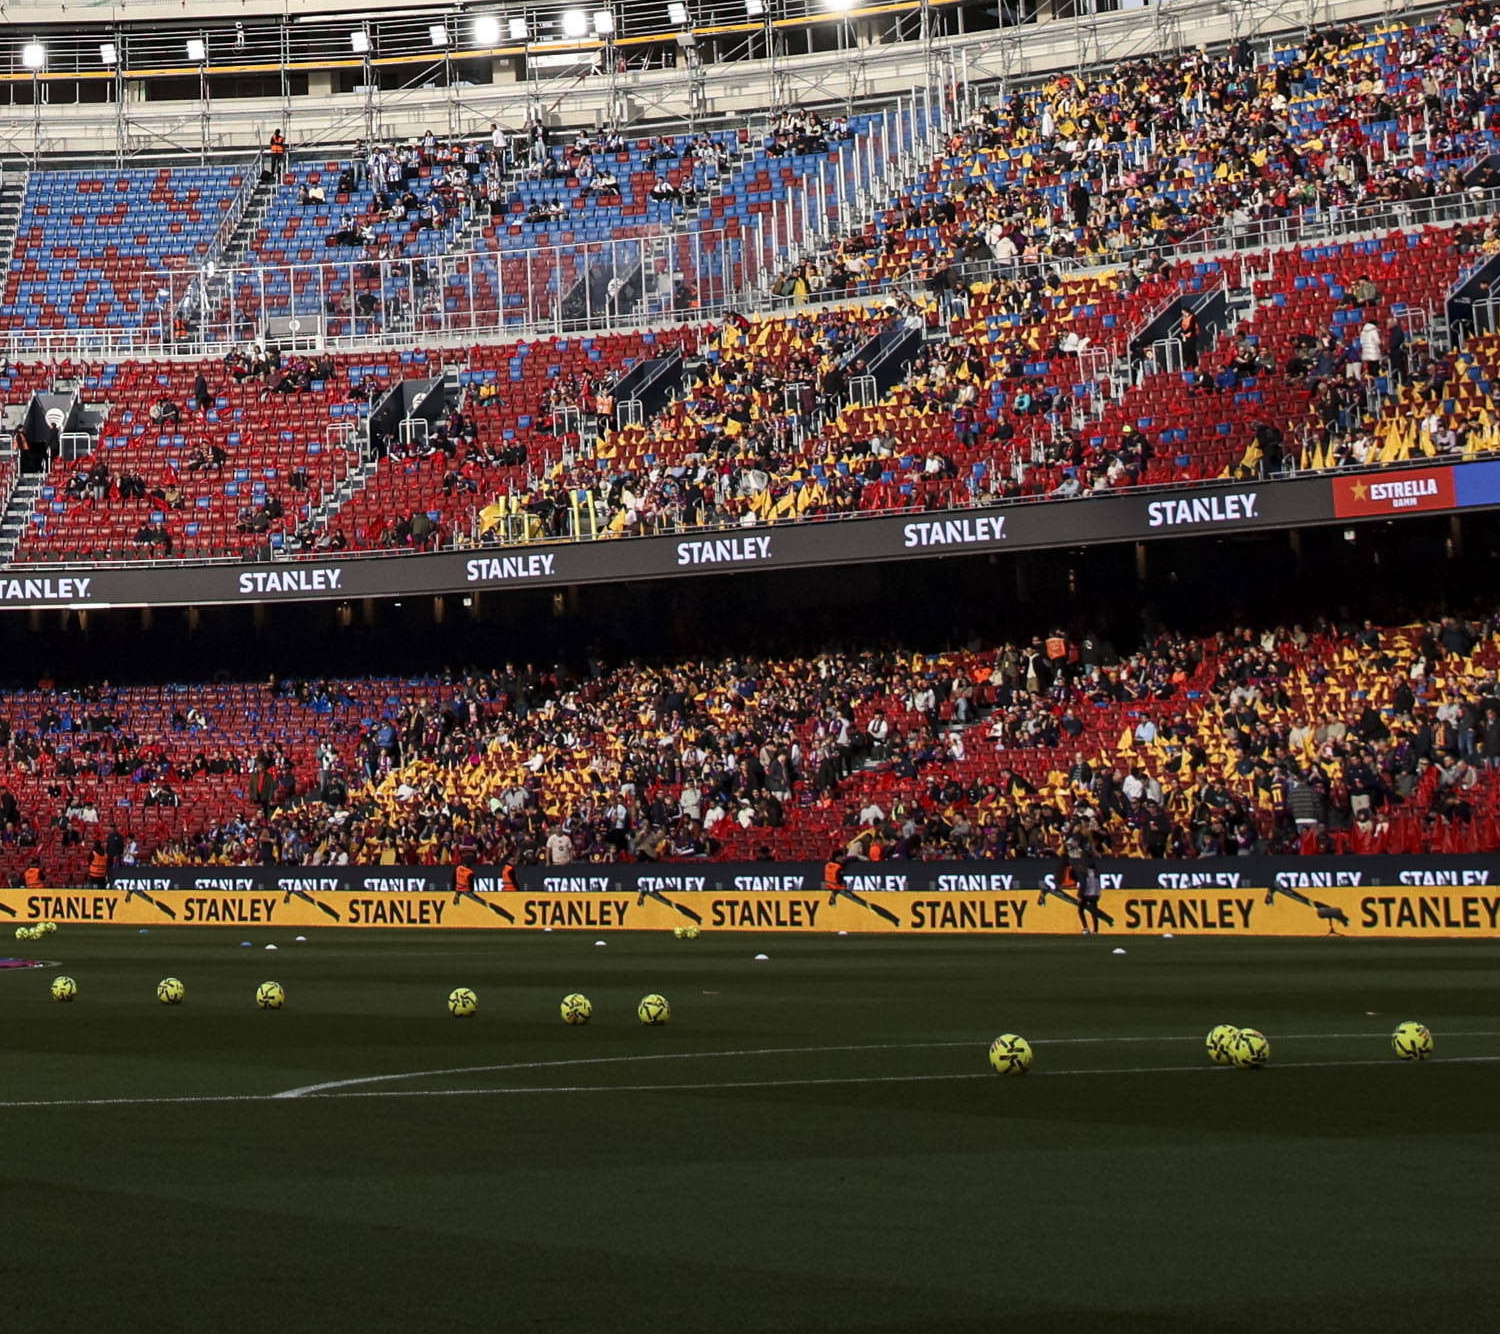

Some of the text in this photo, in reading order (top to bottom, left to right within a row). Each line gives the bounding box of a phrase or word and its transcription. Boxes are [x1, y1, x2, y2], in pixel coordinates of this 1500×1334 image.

[1370, 478, 1438, 501] ESTRELLA
[1393, 498, 1417, 507] DAMM
[843, 875, 907, 891] TANLEY
[27, 897, 117, 921] STANLEY
[184, 898, 275, 923] STANLEY
[348, 899, 445, 924] STANLEY
[524, 900, 629, 926] STANLEY
[712, 900, 820, 927] STANLEY
[911, 899, 1028, 928] STANLEY
[1125, 898, 1254, 929] STANLEY
